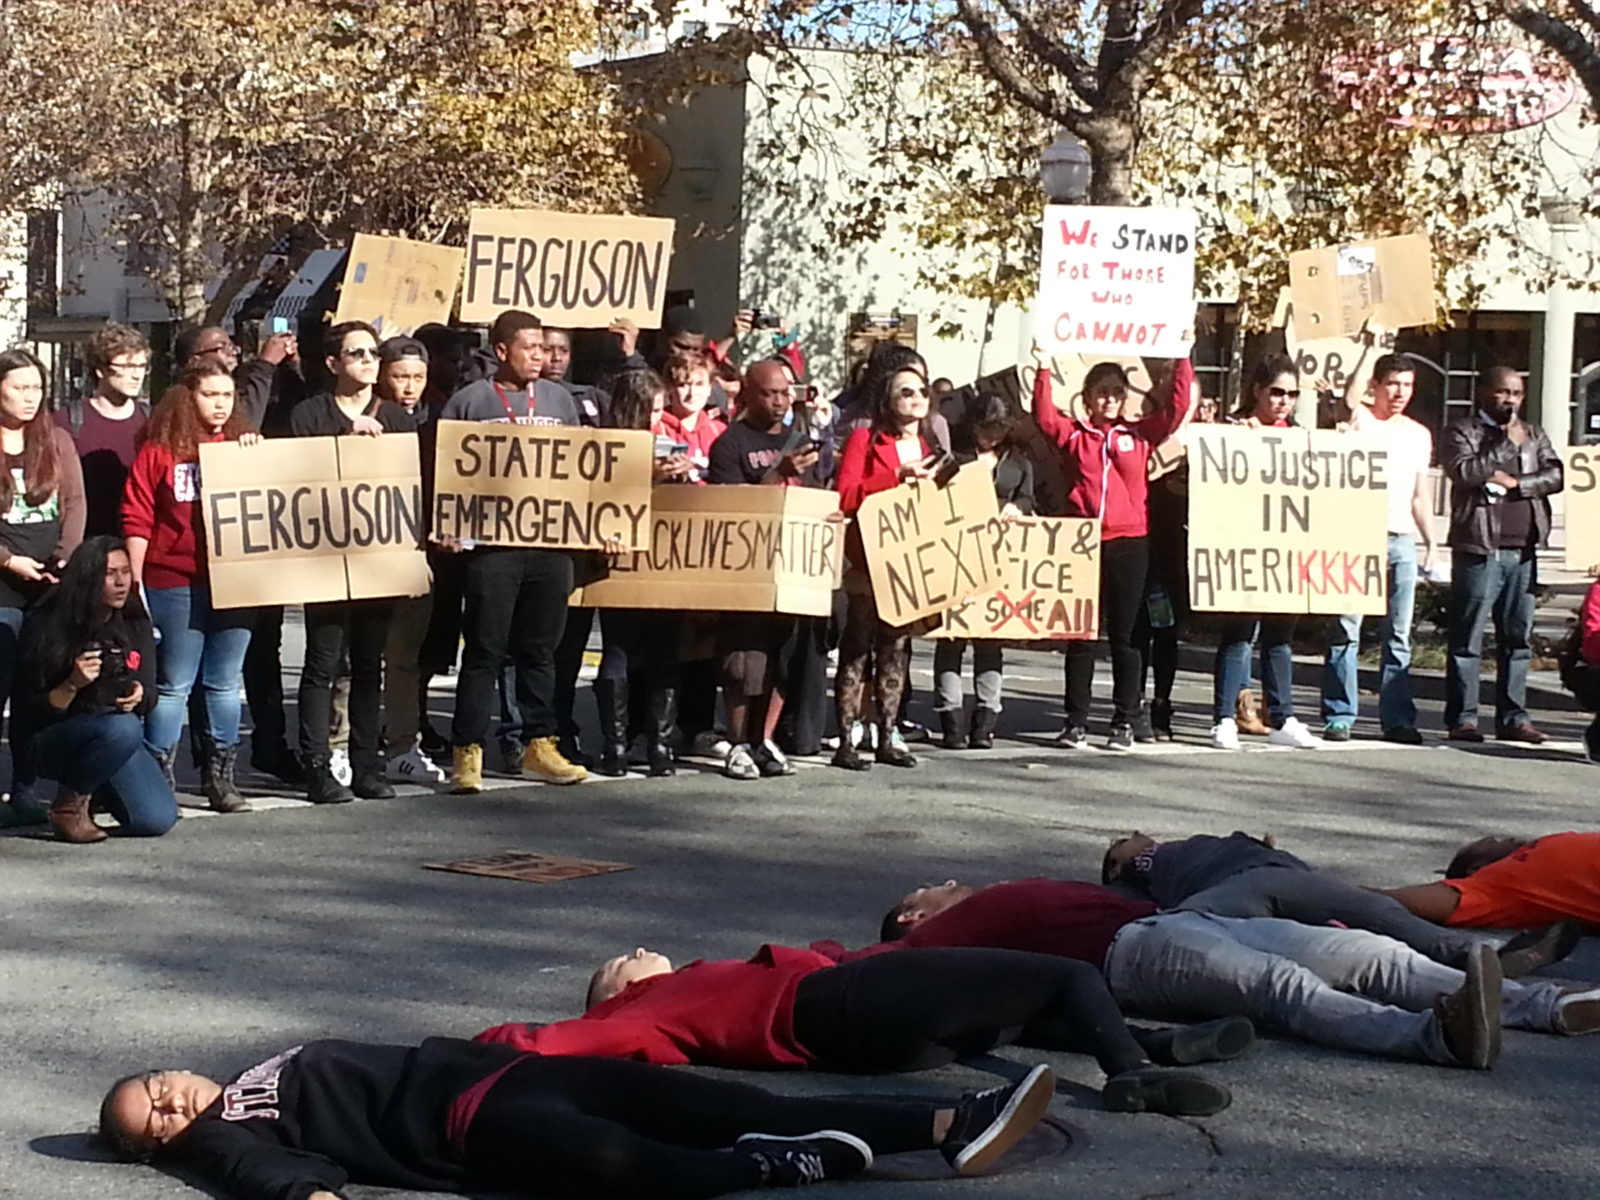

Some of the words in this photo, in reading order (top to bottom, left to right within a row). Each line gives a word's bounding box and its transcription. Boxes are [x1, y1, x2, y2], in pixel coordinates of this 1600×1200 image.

[1112, 224, 1188, 254] STAND
[467, 234, 664, 311] FERGUSON
[1057, 260, 1089, 280] FOR
[1102, 262, 1164, 283] THOSE
[1092, 290, 1133, 305] WHO
[1054, 312, 1167, 346] CANNOT
[455, 434, 570, 480] STATE
[578, 440, 626, 483] OF
[1260, 436, 1388, 490] JUSTICE
[1570, 452, 1600, 492] S
[210, 483, 422, 557] FERGUSON
[436, 493, 648, 548] EMERGENCY
[873, 497, 920, 549] AM
[943, 482, 965, 526] I
[1262, 494, 1310, 533] IN
[1071, 521, 1099, 561] &
[885, 517, 1004, 617] NEXT?
[1192, 548, 1382, 606] AMERIKKKA
